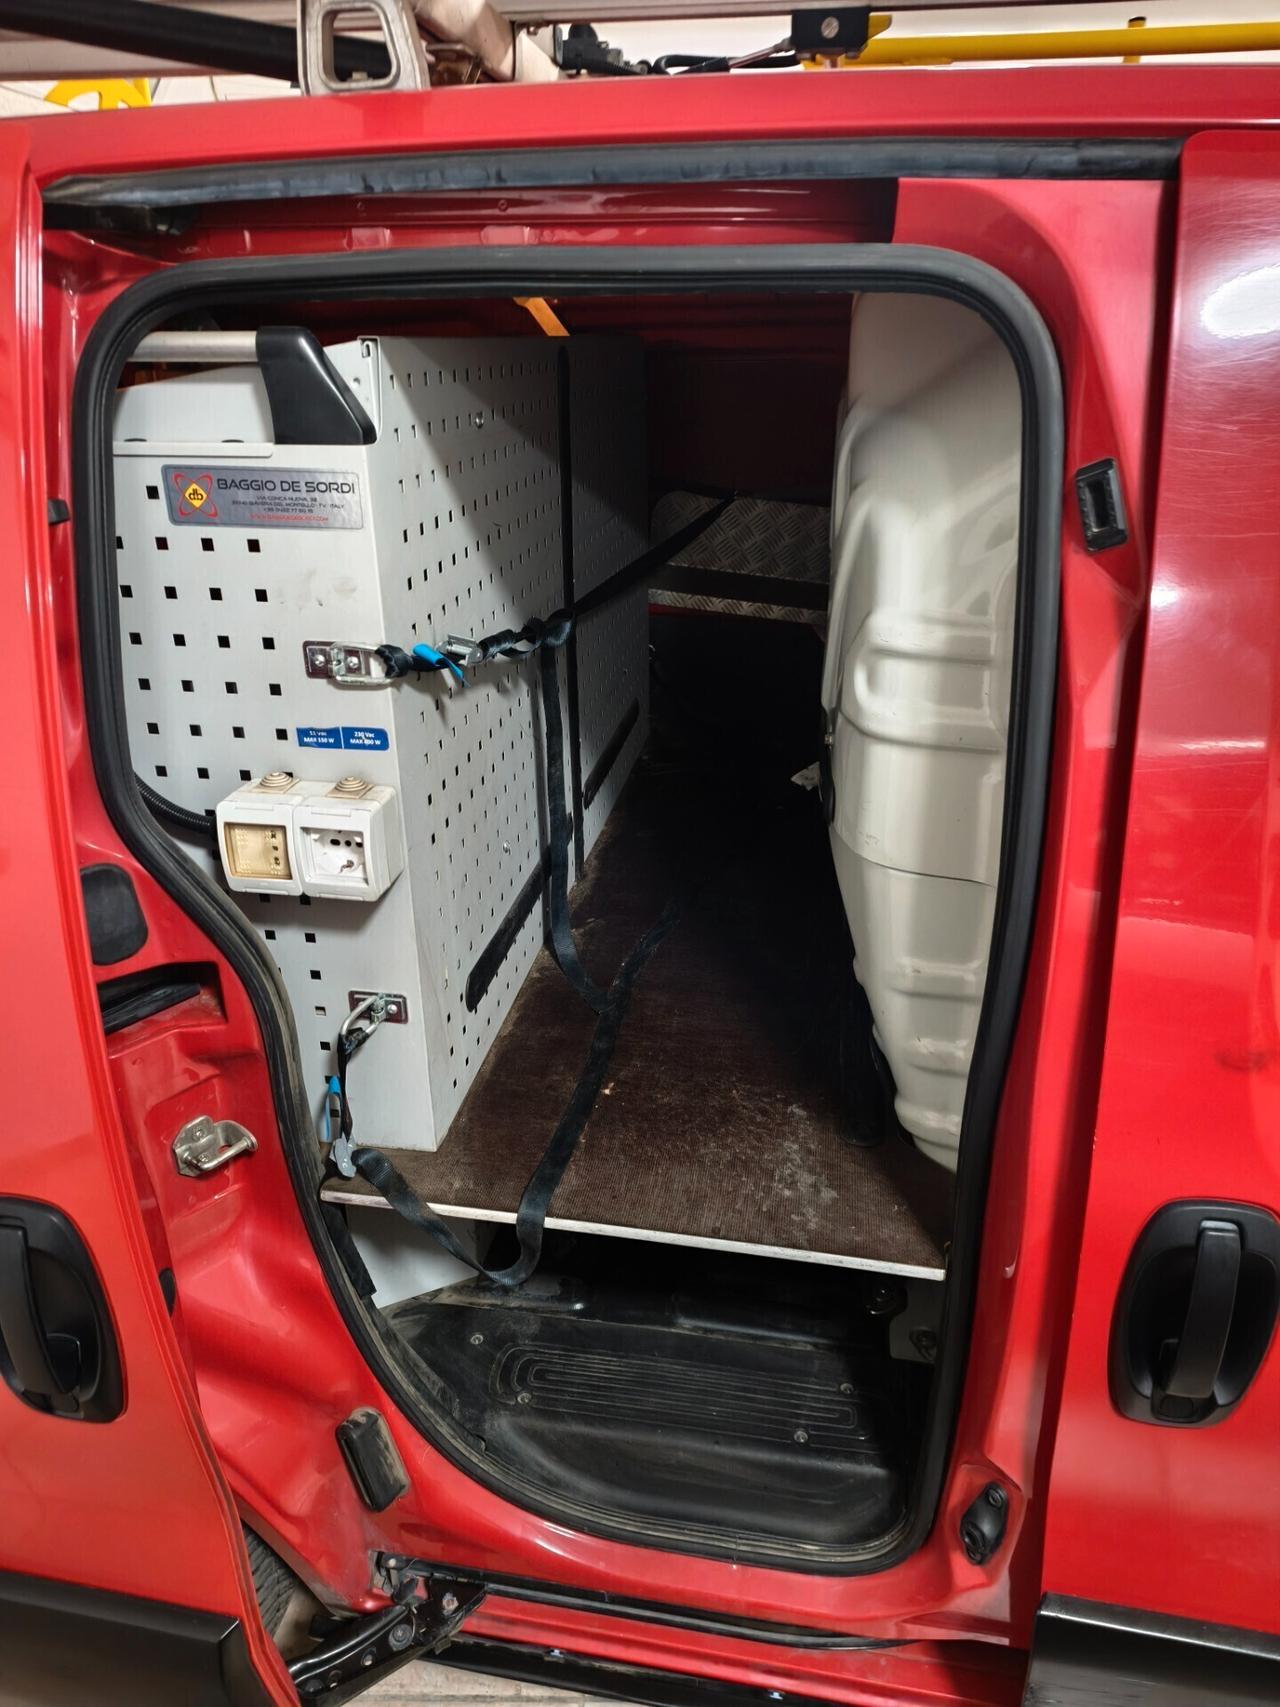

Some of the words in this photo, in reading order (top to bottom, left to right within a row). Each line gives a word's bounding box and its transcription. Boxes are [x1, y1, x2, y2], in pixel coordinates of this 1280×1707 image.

[217, 478, 276, 491] BAGGIO
[280, 480, 302, 492] DE
[304, 481, 355, 494] SORDI
